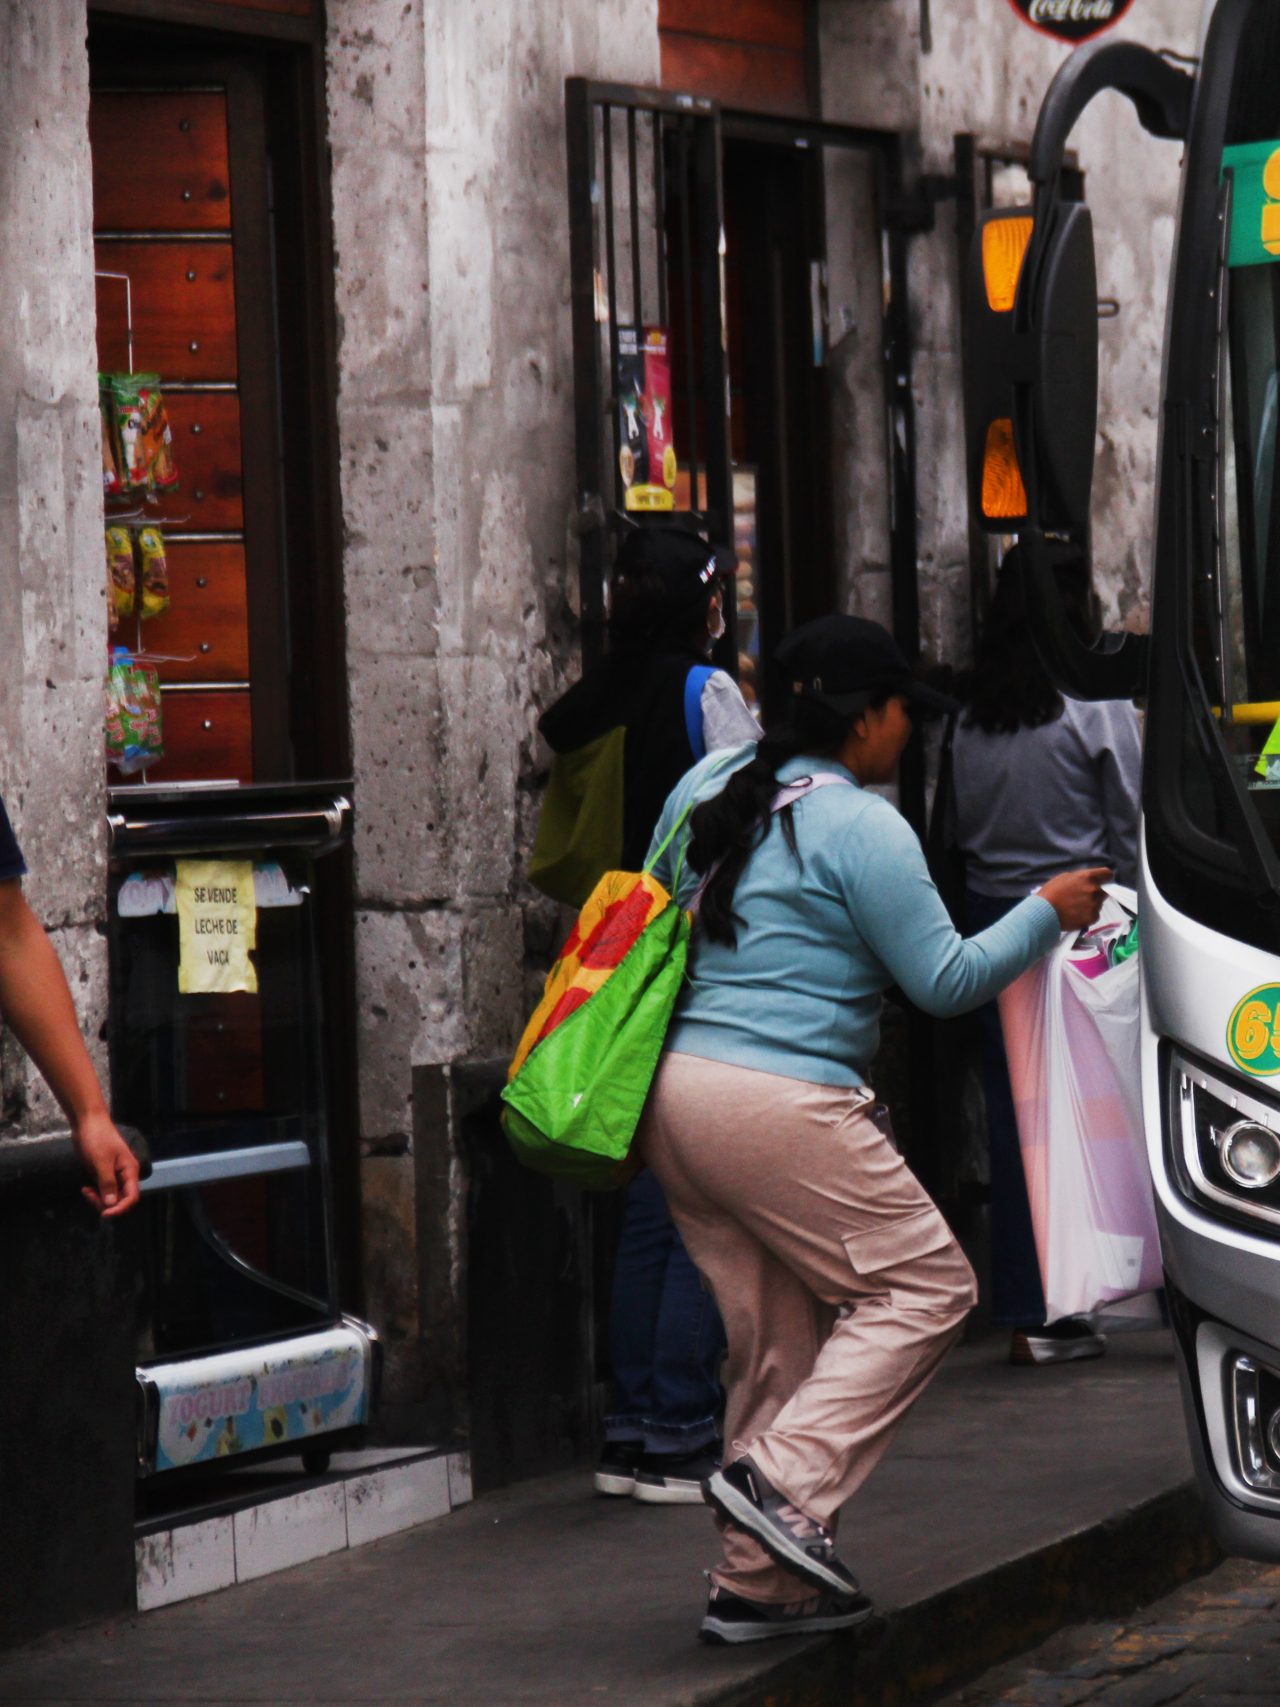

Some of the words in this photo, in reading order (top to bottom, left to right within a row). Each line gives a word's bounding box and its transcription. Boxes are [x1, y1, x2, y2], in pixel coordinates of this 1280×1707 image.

[194, 887, 205, 903] SE
[207, 887, 238, 903] VENDE
[195, 919, 224, 935] LECHE
[226, 919, 239, 935] DE
[206, 950, 230, 965] VACA
